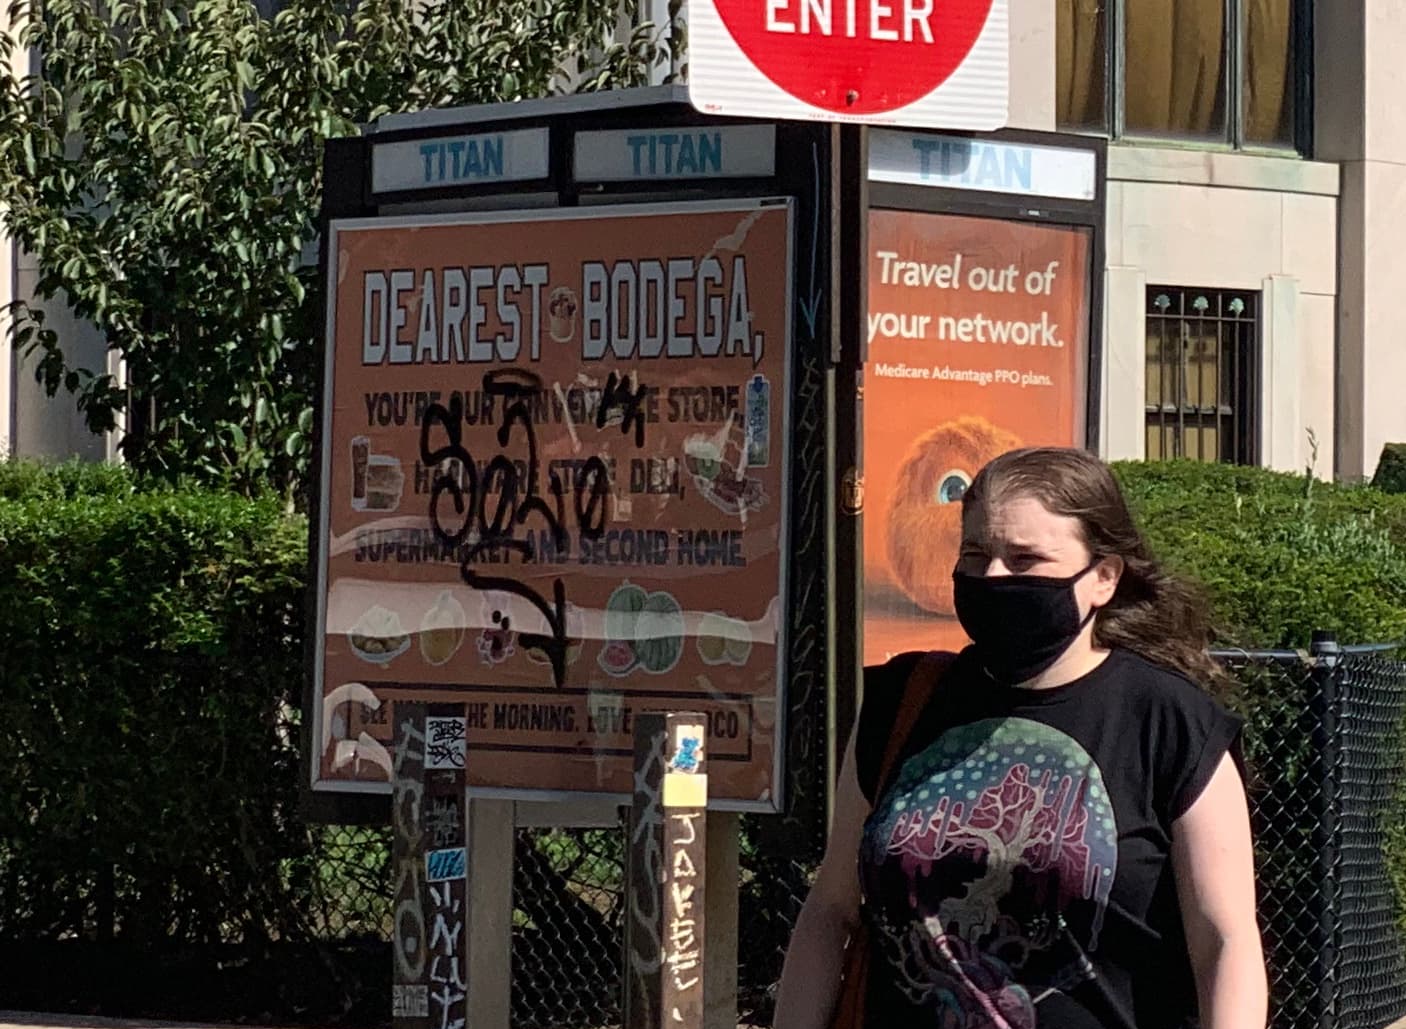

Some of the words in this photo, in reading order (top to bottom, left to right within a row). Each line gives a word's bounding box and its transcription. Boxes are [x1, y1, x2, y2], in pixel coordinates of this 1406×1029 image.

[766, 0, 935, 43] ENTER
[419, 138, 504, 181] TITAN
[627, 132, 722, 176] TITAN
[912, 138, 1032, 189] TITAN
[876, 251, 960, 290] Travel
[968, 263, 1018, 294] out
[1024, 260, 1060, 297] of
[361, 262, 549, 366] DEAREST
[581, 255, 765, 370] BODEGA,
[867, 311, 935, 345] your
[938, 310, 1065, 349] network.
[874, 362, 929, 380] Medicare
[932, 365, 993, 386] Advantage
[994, 369, 1020, 384] PPO
[1021, 371, 1054, 388] plans.
[355, 528, 509, 564] SUPERMET
[676, 528, 747, 566] HOME
[467, 702, 488, 729] HE
[494, 702, 579, 733] MORNING.
[706, 709, 739, 739] OCO
